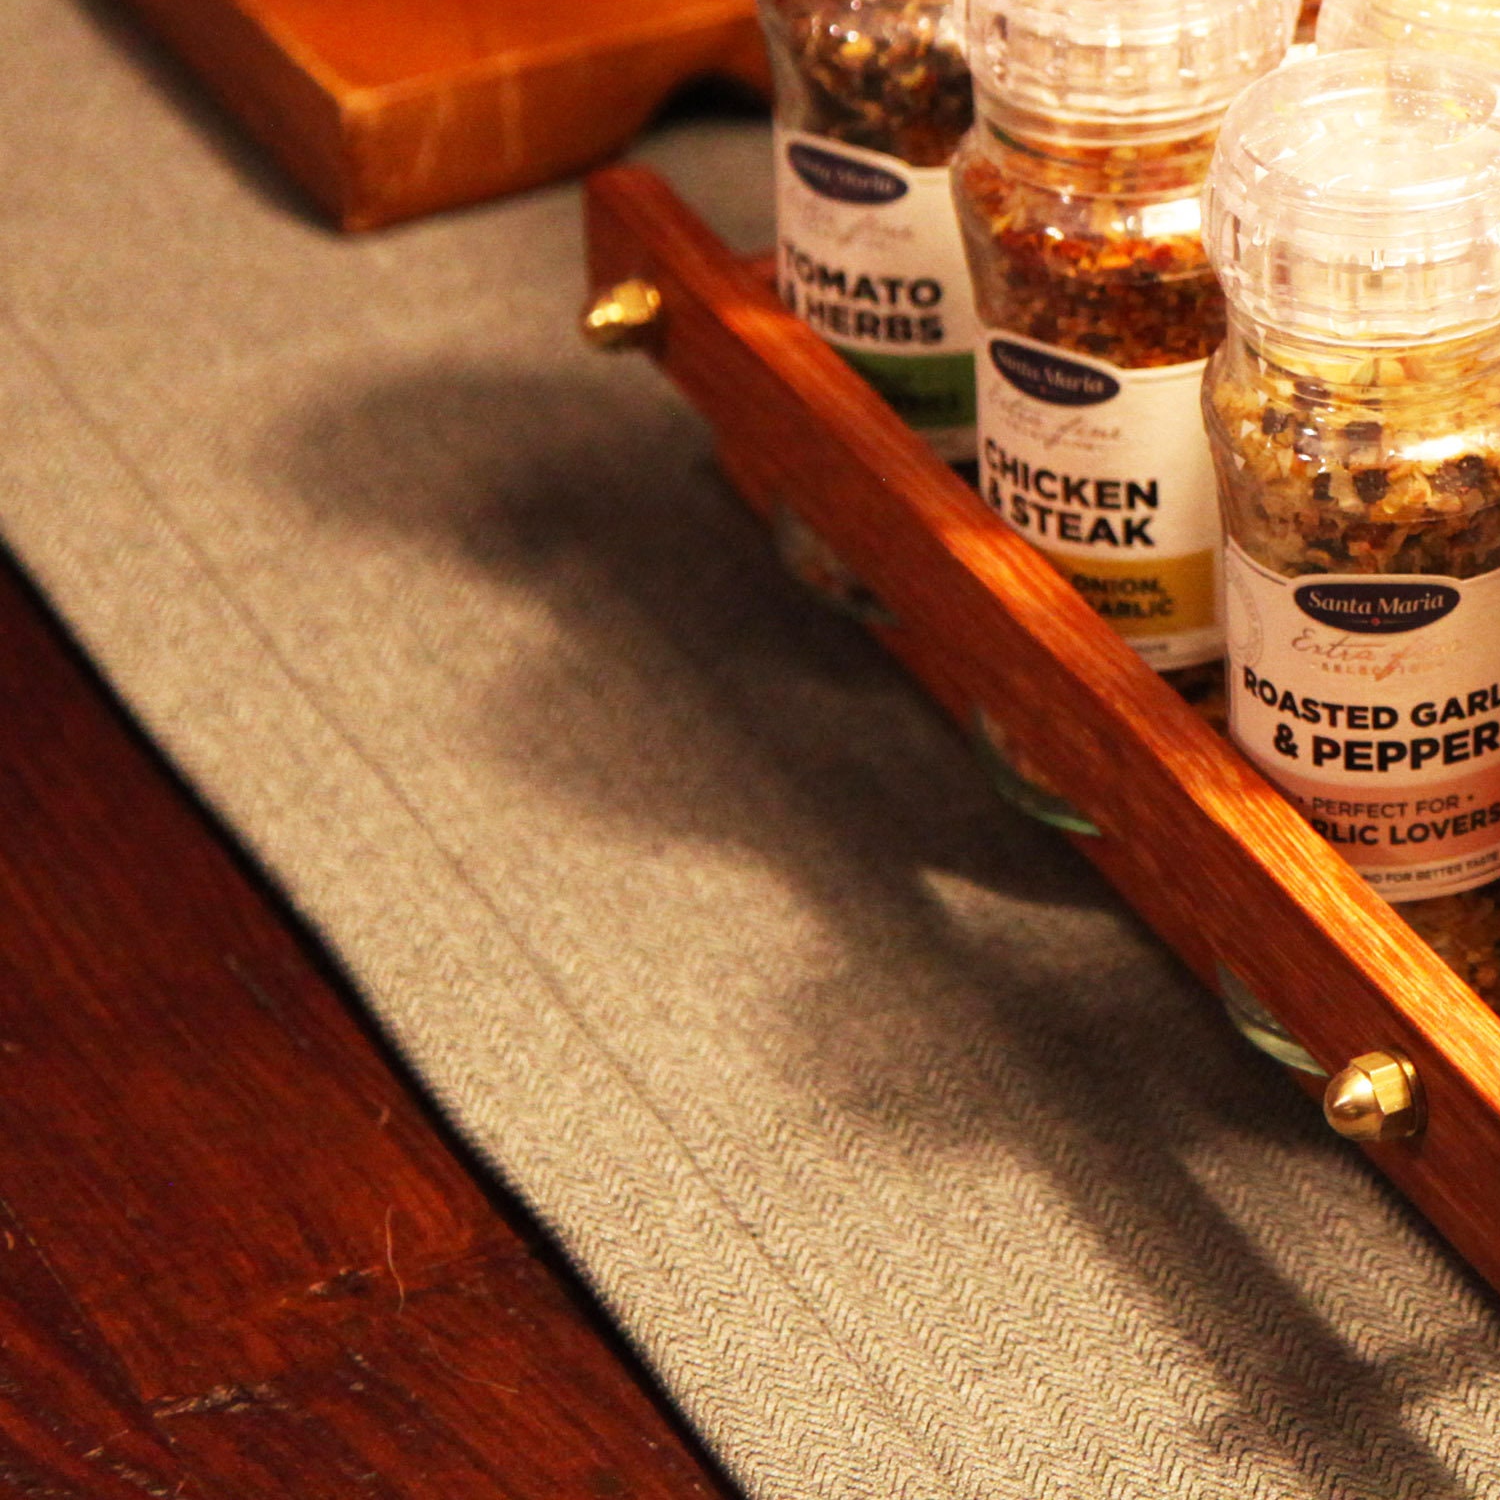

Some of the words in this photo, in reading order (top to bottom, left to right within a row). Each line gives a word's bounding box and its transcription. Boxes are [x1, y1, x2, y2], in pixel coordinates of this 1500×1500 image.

[783, 241, 943, 308] TOMATO
[807, 298, 944, 344] HERBS
[984, 437, 1159, 511] CHICKEN
[1010, 495, 1156, 547] STEAK
[1309, 591, 1372, 615] Santa
[1378, 592, 1446, 615] Maria
[1291, 627, 1384, 662] Extra
[1243, 666, 1398, 730] ROASTED
[1274, 723, 1299, 759] &
[1311, 721, 1500, 772] PEPPER
[1313, 797, 1408, 819] PERFECT
[1416, 795, 1460, 817] FOR
